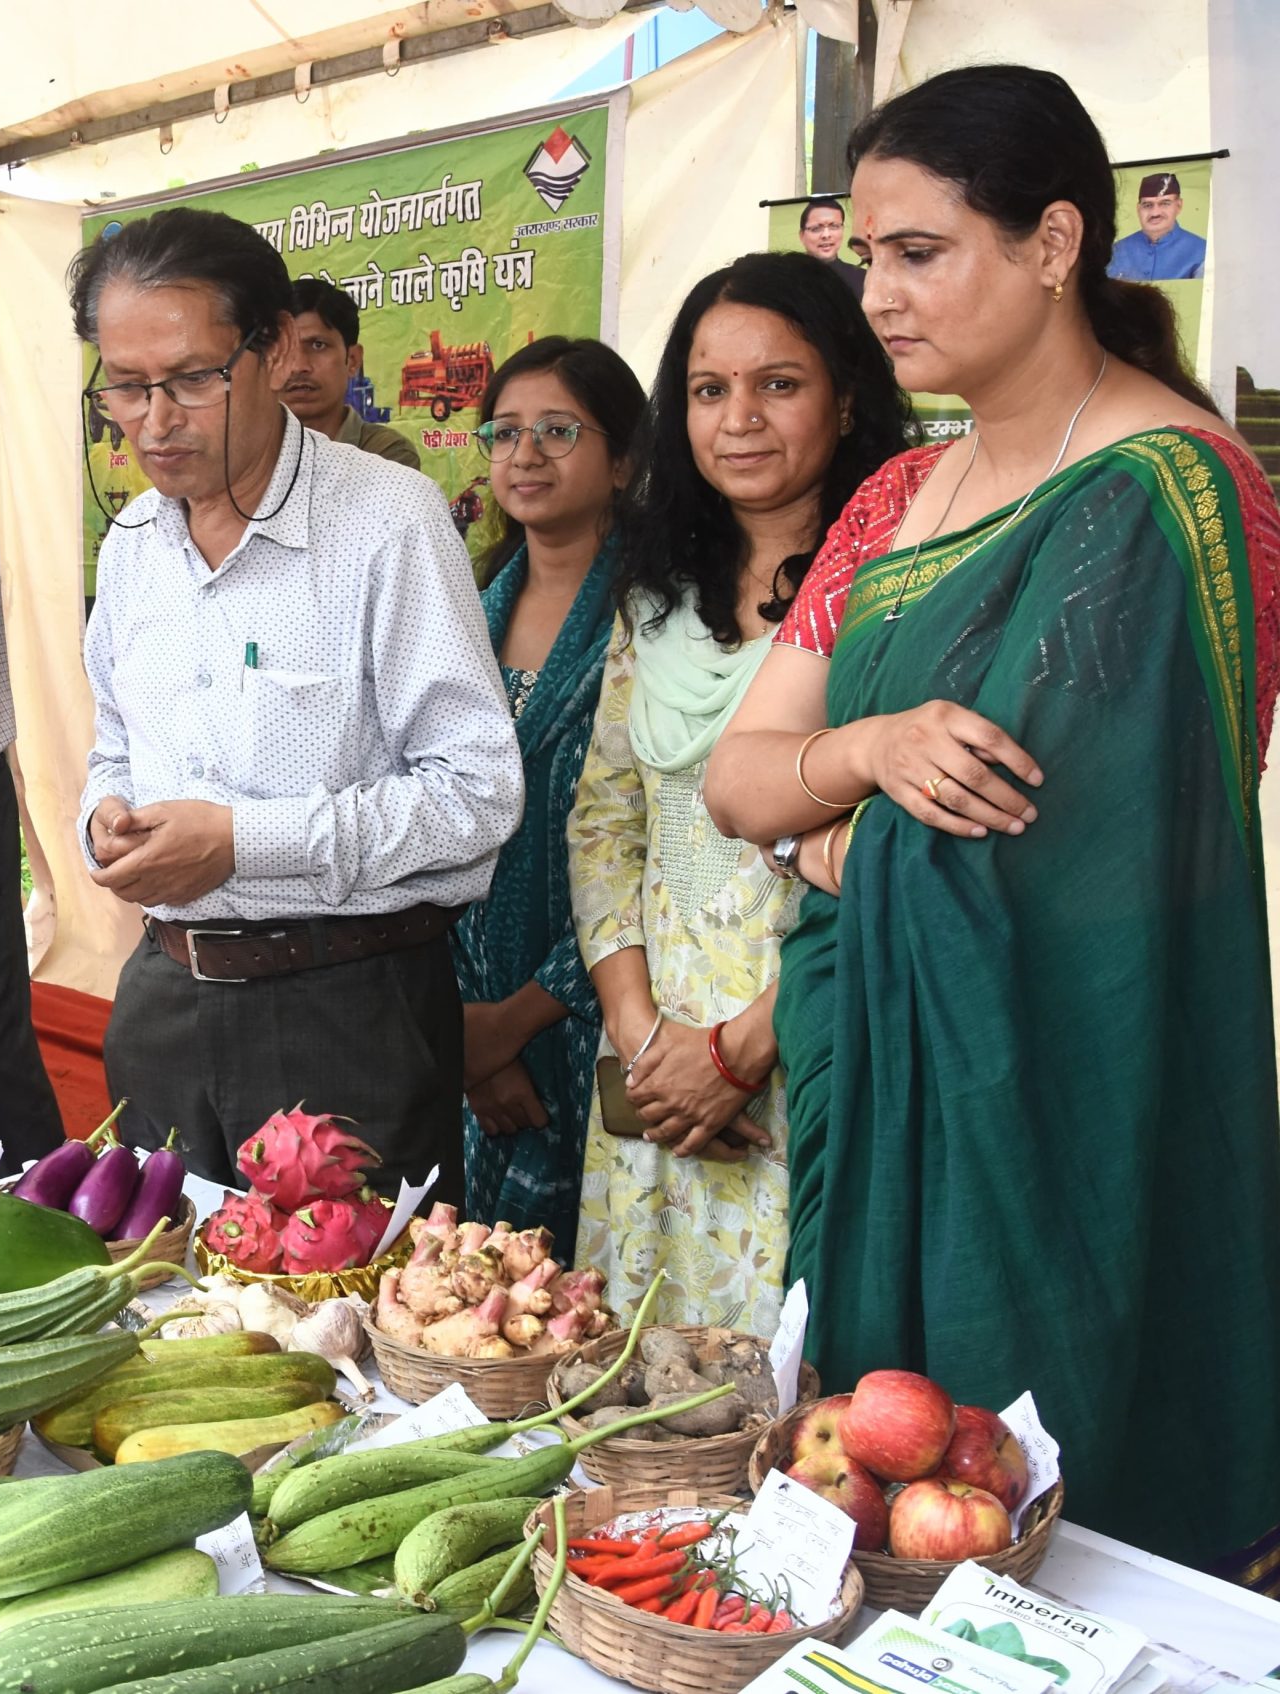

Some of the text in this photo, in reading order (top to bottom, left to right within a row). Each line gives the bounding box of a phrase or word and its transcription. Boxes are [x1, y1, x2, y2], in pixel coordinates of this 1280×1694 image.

[288, 201, 357, 252] विभिन्न
[514, 213, 600, 238] उत्तराखण्ड सरकार
[390, 253, 436, 306] वाले
[439, 247, 488, 312] कृषि
[492, 238, 536, 292] यंत्र
[922, 419, 974, 437] रम्भ
[993, 1603, 1071, 1638] HYBRID SEEDS
[879, 1654, 935, 1681] pahuja
